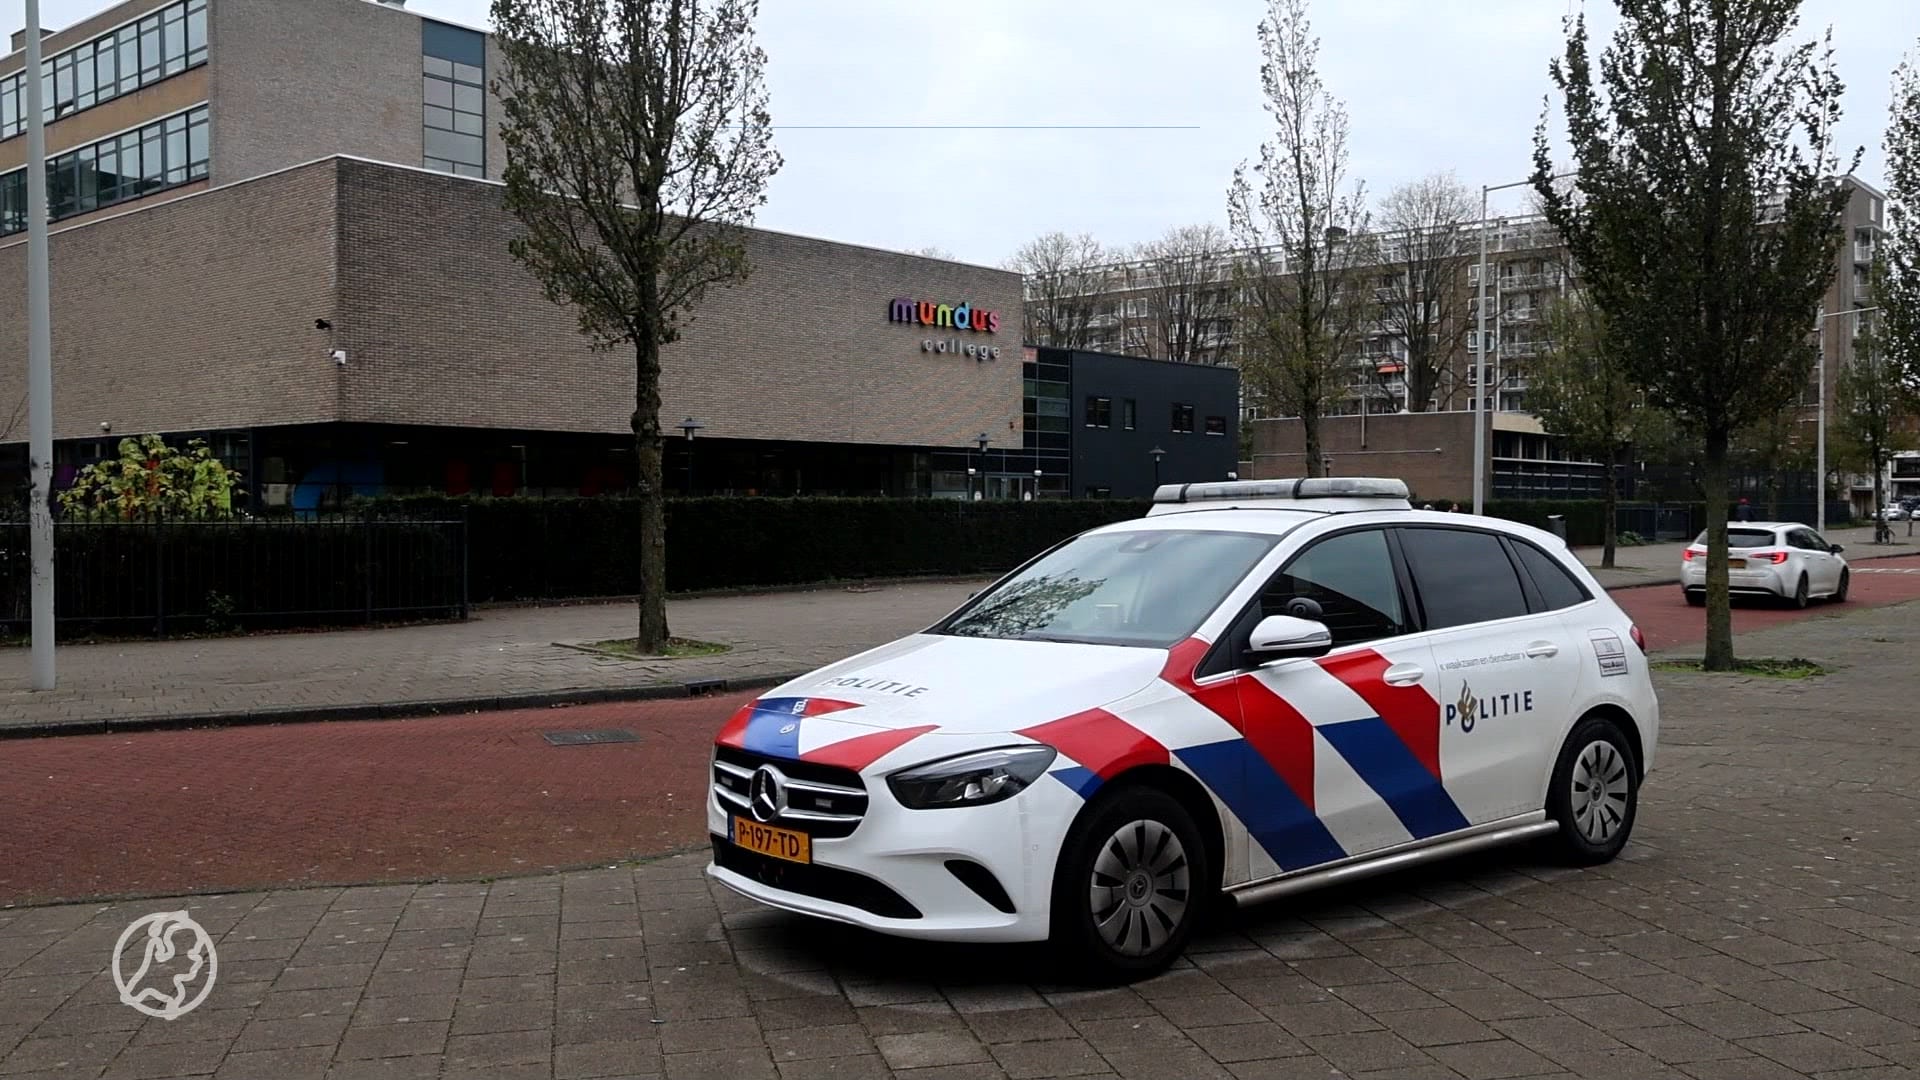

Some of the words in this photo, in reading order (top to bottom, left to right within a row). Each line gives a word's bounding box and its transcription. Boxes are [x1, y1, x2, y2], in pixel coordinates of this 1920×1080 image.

[891, 299, 1000, 332] mundus
[922, 339, 1000, 360] college
[820, 677, 930, 698] POLITIE
[1446, 690, 1533, 733] POLITIE
[738, 821, 800, 857] P-197-TD
